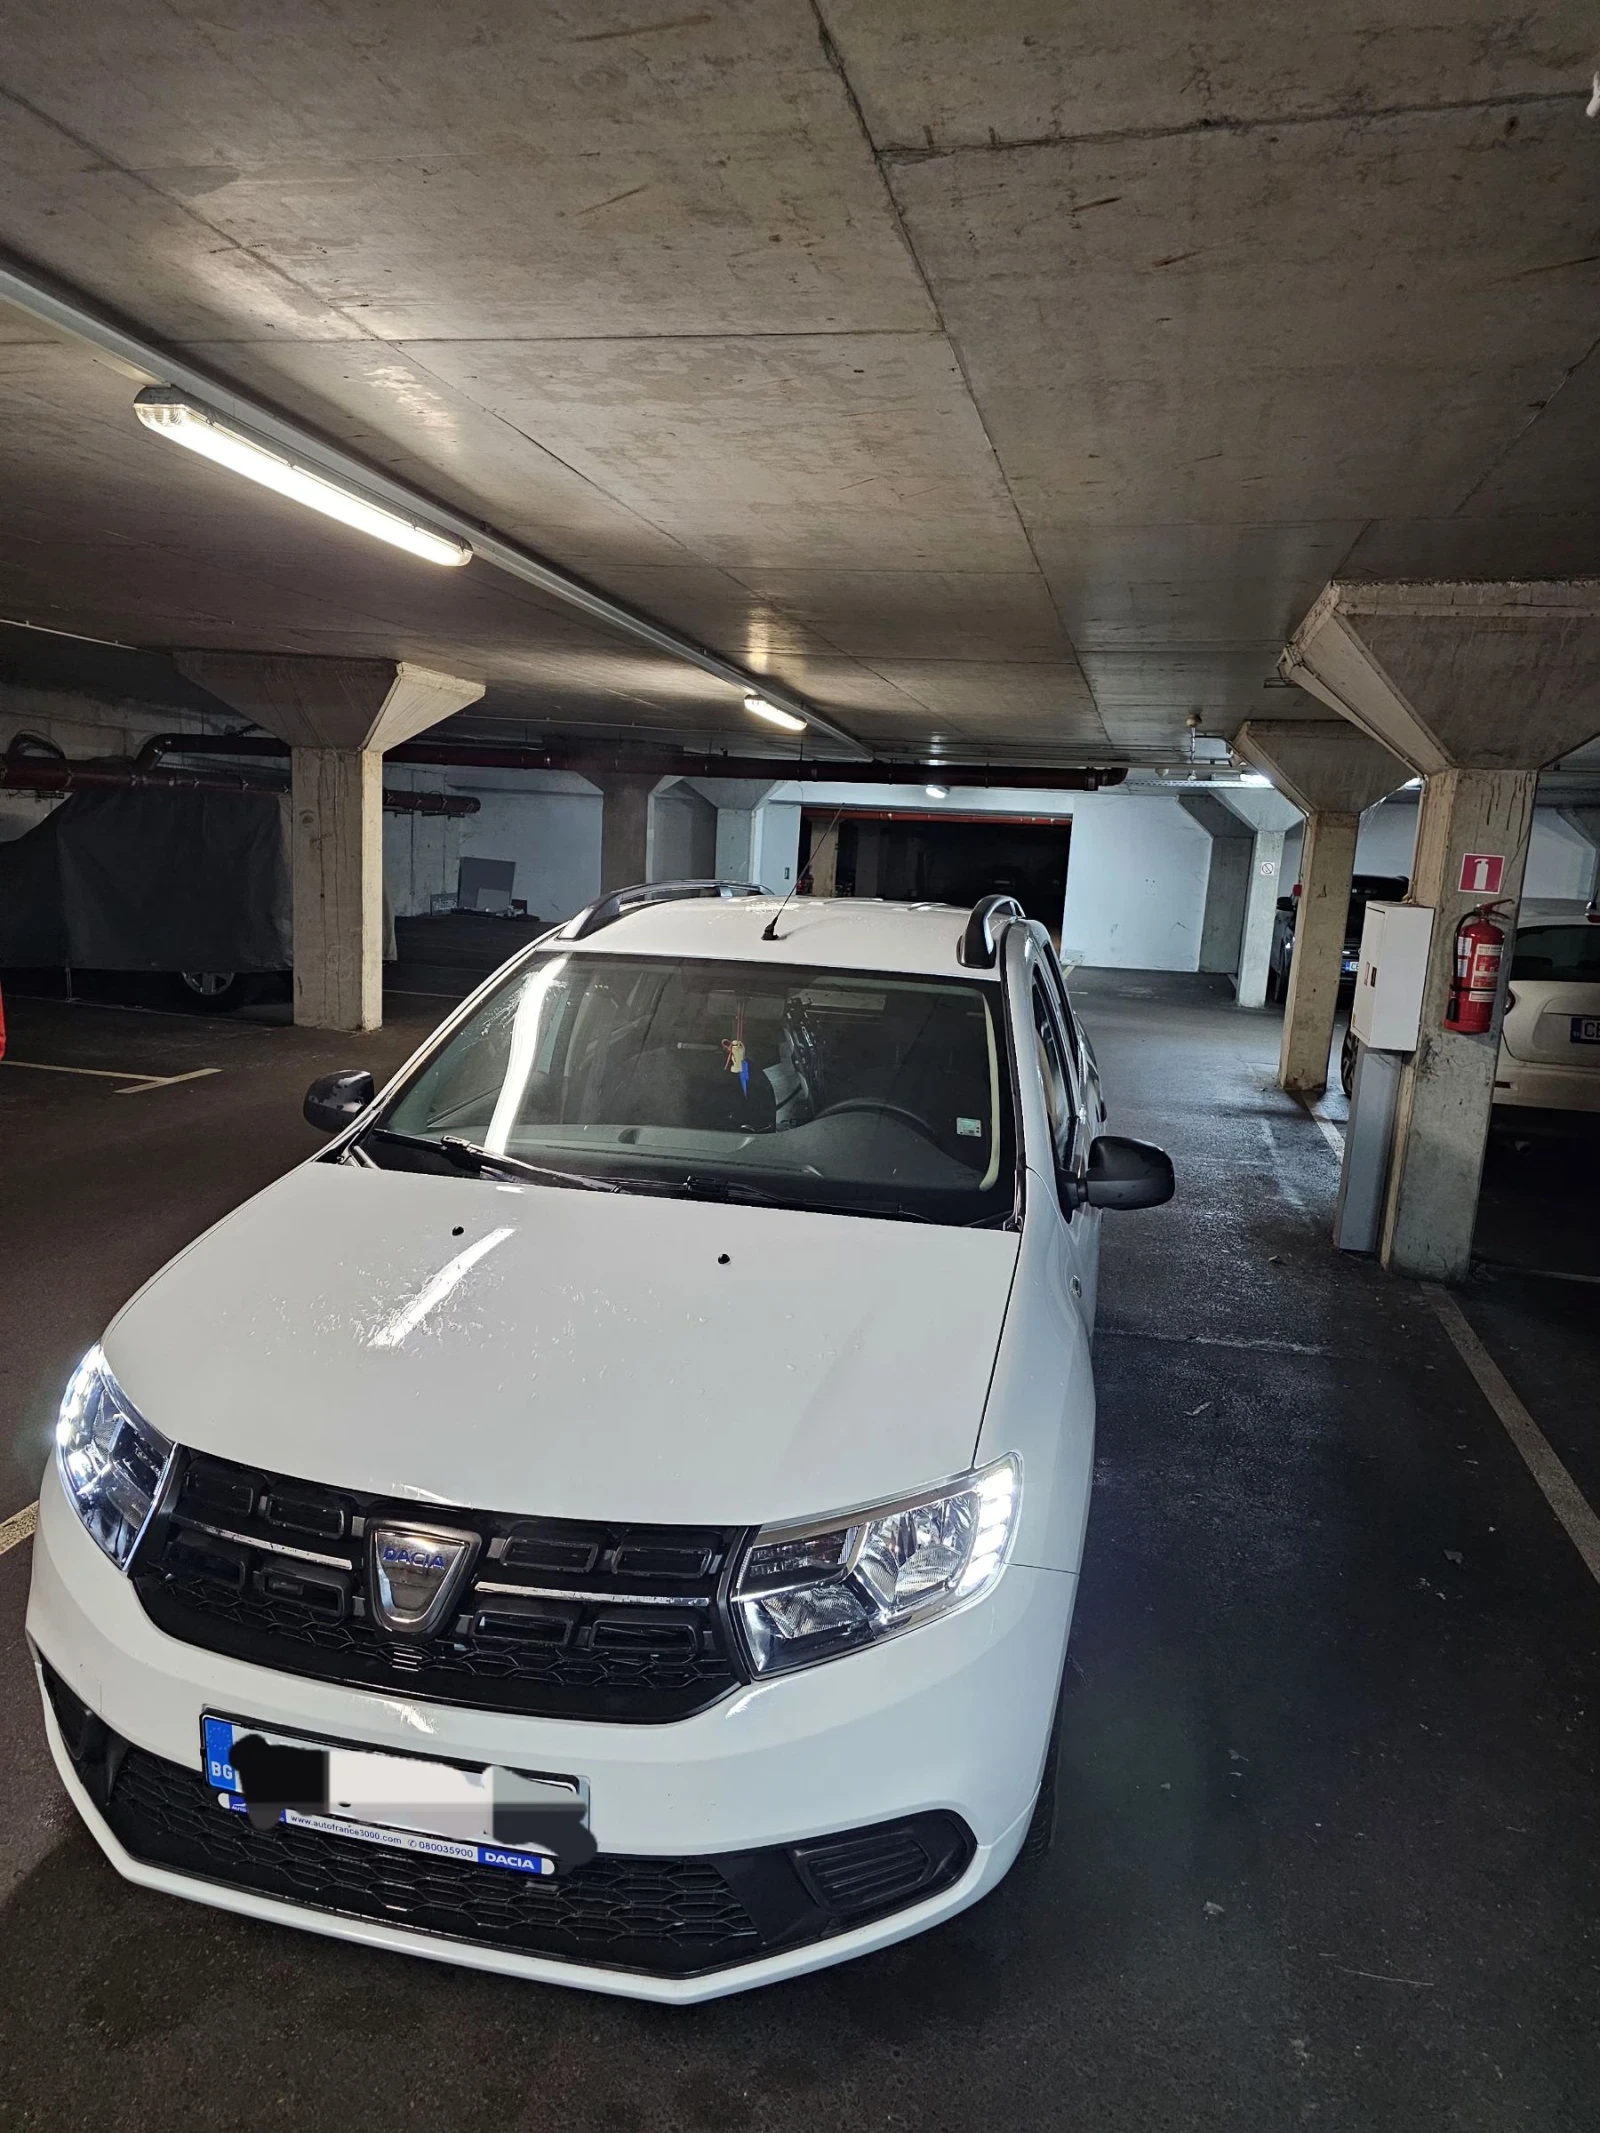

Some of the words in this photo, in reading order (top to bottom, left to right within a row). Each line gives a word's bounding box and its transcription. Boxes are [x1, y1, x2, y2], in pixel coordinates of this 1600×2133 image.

[383, 1547, 446, 1569] DACIA
[211, 1762, 233, 1780] BG
[290, 1815, 402, 1845] www.autofrance3000.com
[418, 1841, 474, 1858] 080035900
[484, 1852, 535, 1870] DACIA
